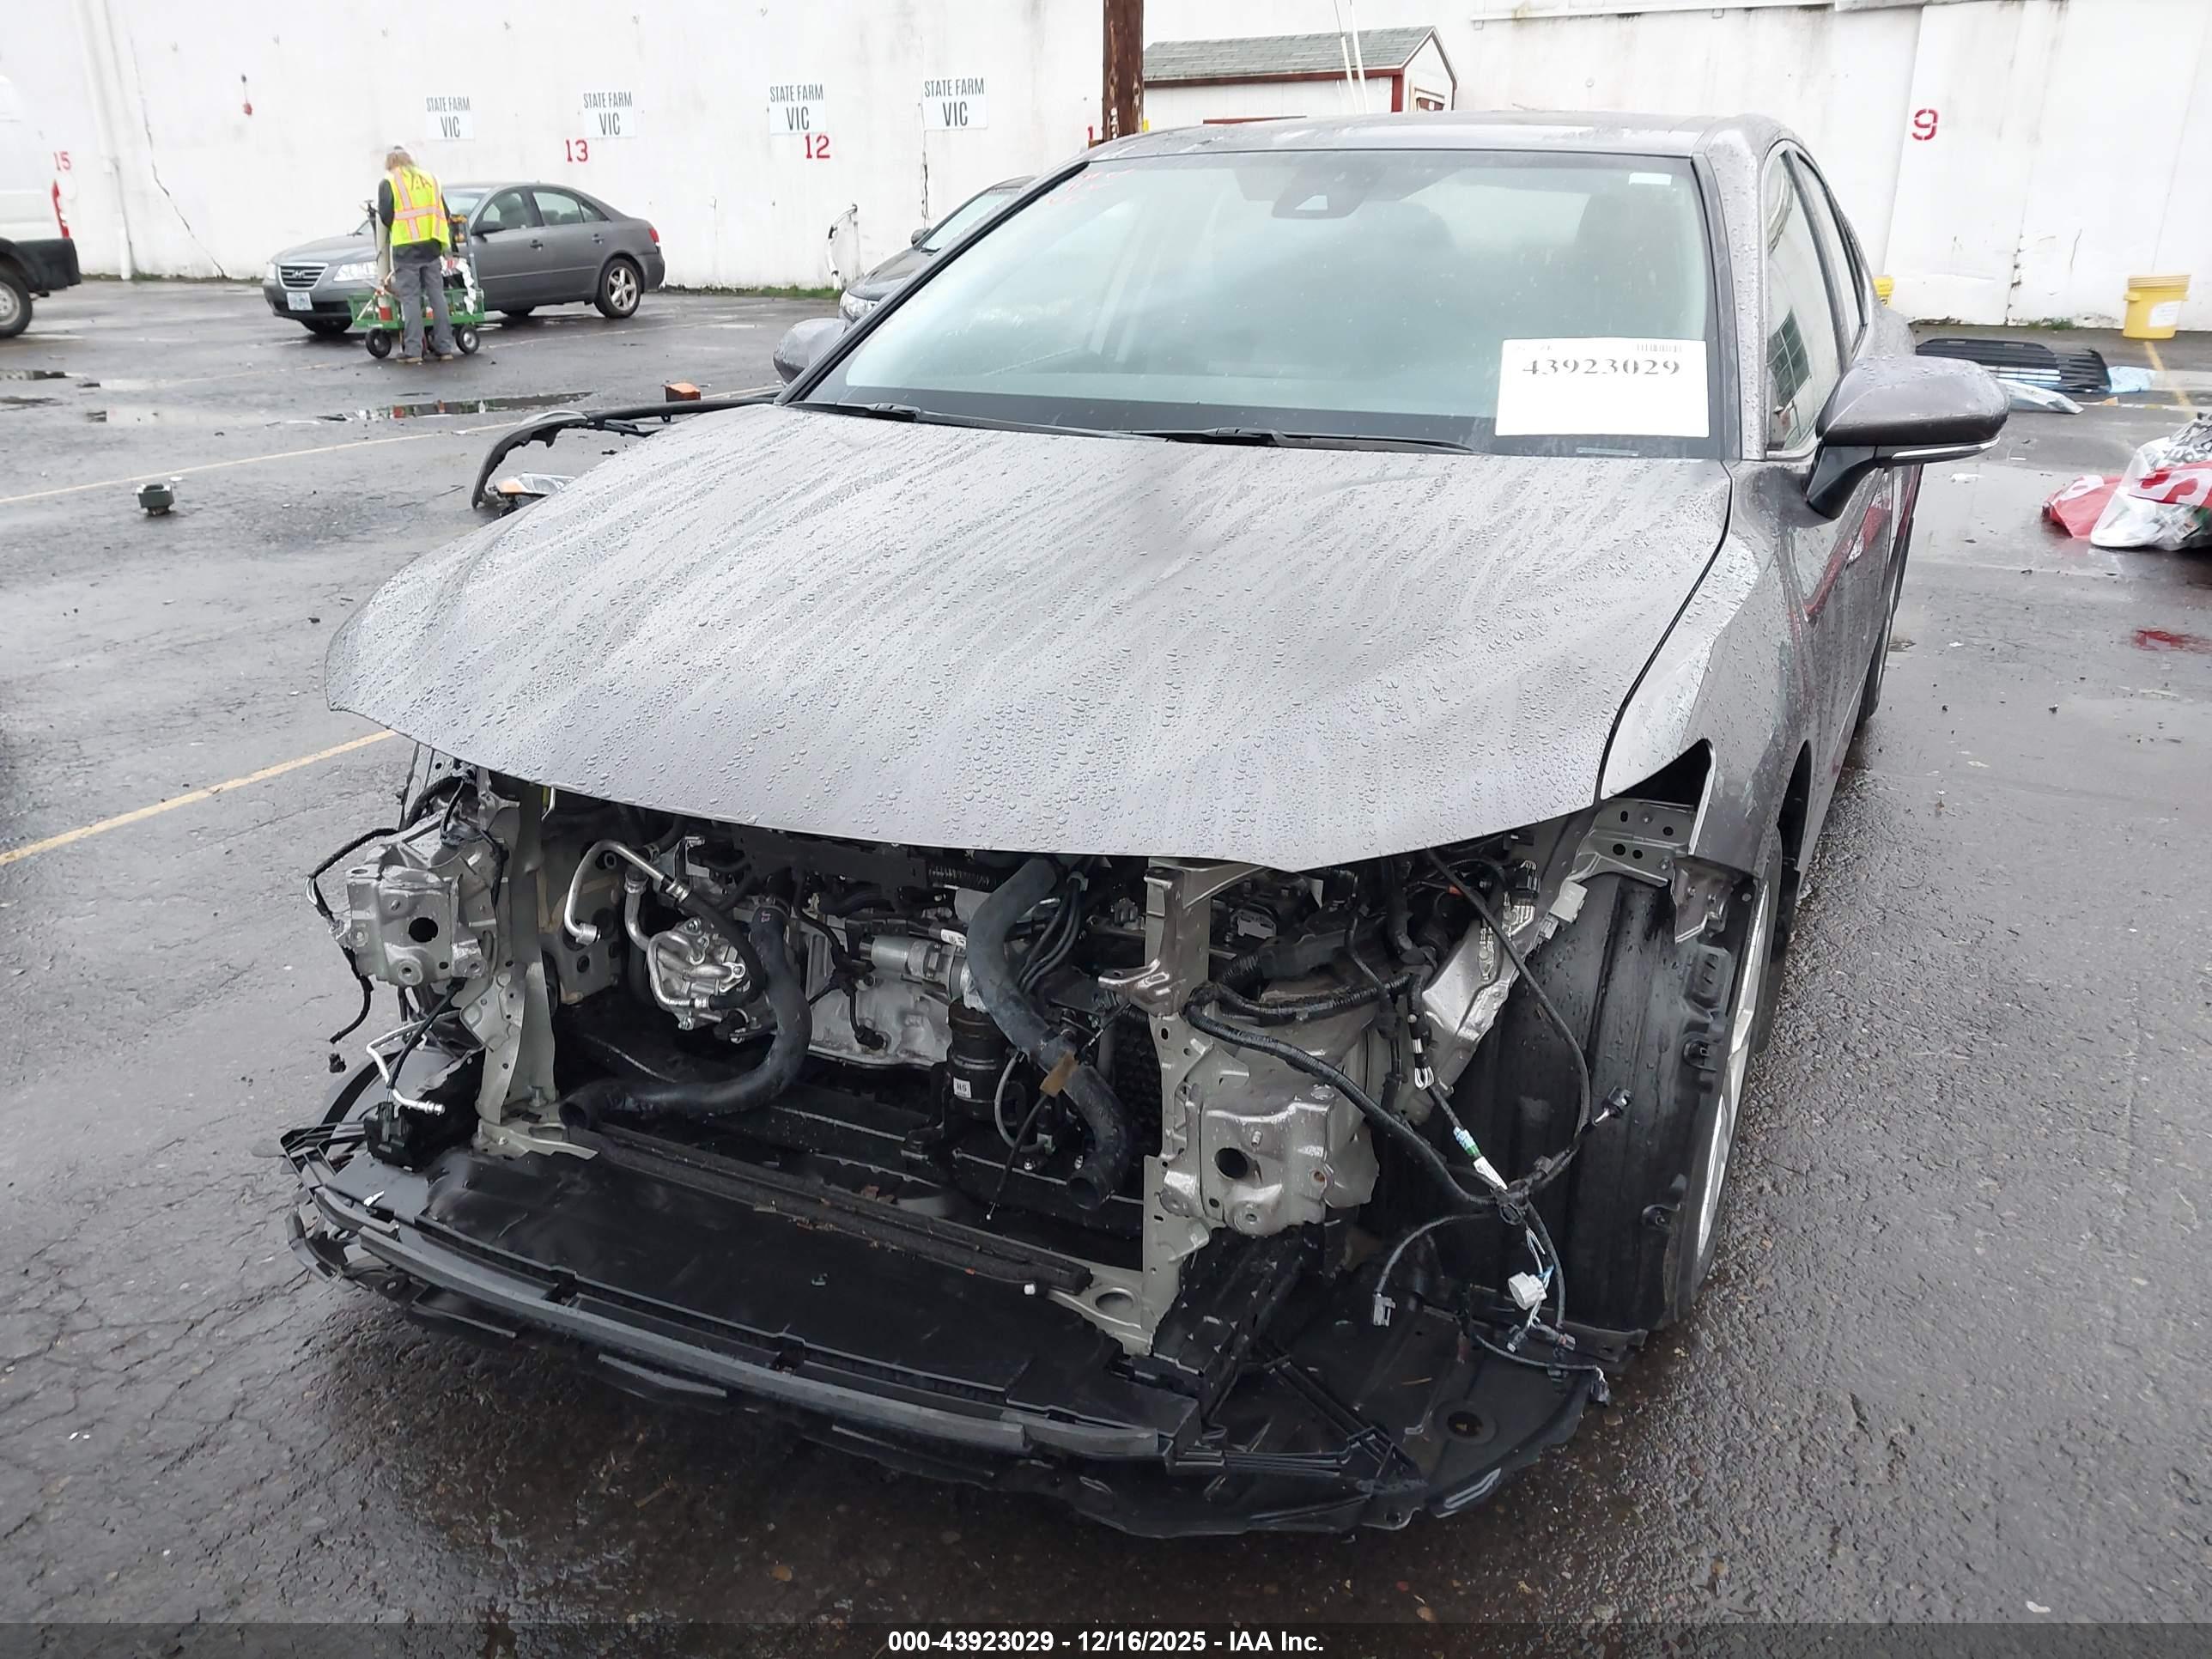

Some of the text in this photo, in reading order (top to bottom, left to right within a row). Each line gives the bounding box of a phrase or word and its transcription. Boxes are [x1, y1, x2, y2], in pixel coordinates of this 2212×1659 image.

[769, 83, 823, 102] STATE FARM
[924, 77, 984, 99] STATE FARM
[426, 96, 471, 112] STATE FARM
[583, 91, 633, 109] STATE FARM
[599, 112, 621, 136] VIC
[786, 106, 810, 131] VIC
[942, 100, 968, 127] VIC
[441, 116, 460, 138] VIC
[1912, 109, 1938, 142] 9
[565, 139, 588, 162] 13
[805, 135, 830, 160] 12
[53, 151, 71, 172] 15
[1522, 358, 1680, 375] 43923029
